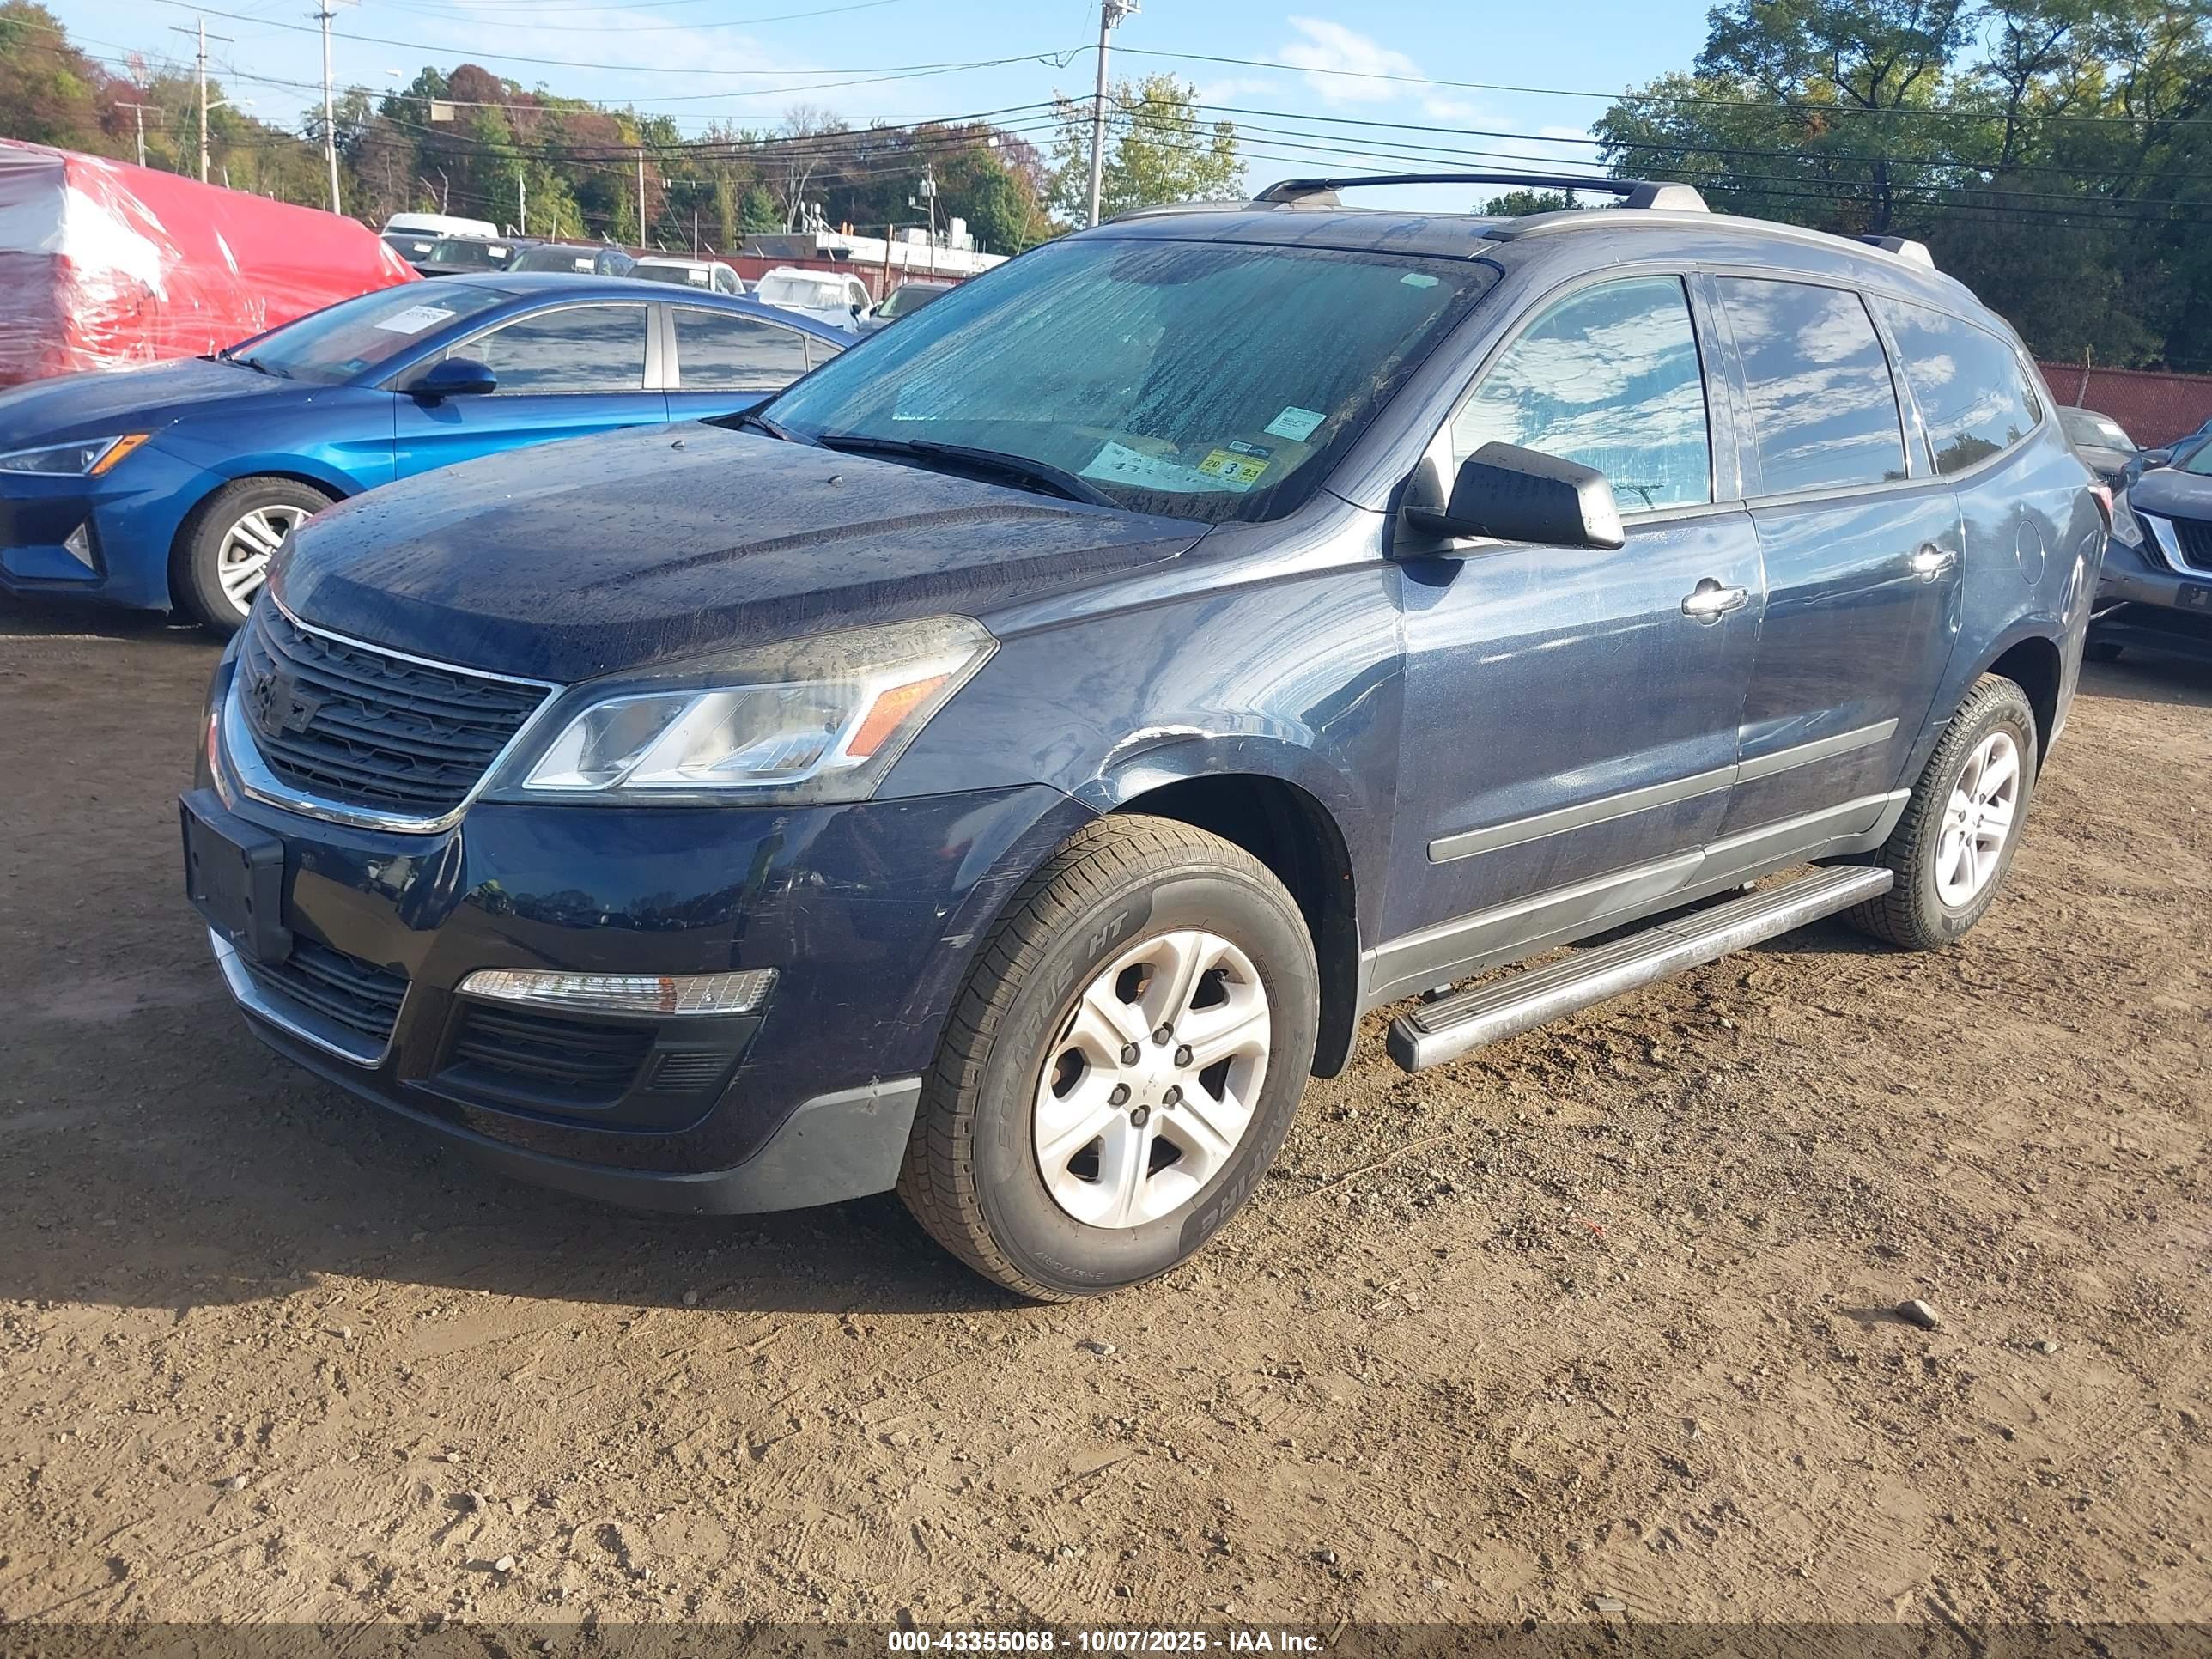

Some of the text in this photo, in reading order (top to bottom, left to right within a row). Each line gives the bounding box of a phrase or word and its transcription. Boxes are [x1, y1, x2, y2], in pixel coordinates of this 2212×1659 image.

[1205, 459, 1259, 477] 20 3 23
[998, 909, 1128, 1149] SOLARUS HT
[1199, 1053, 1302, 1233] STARFIRE
